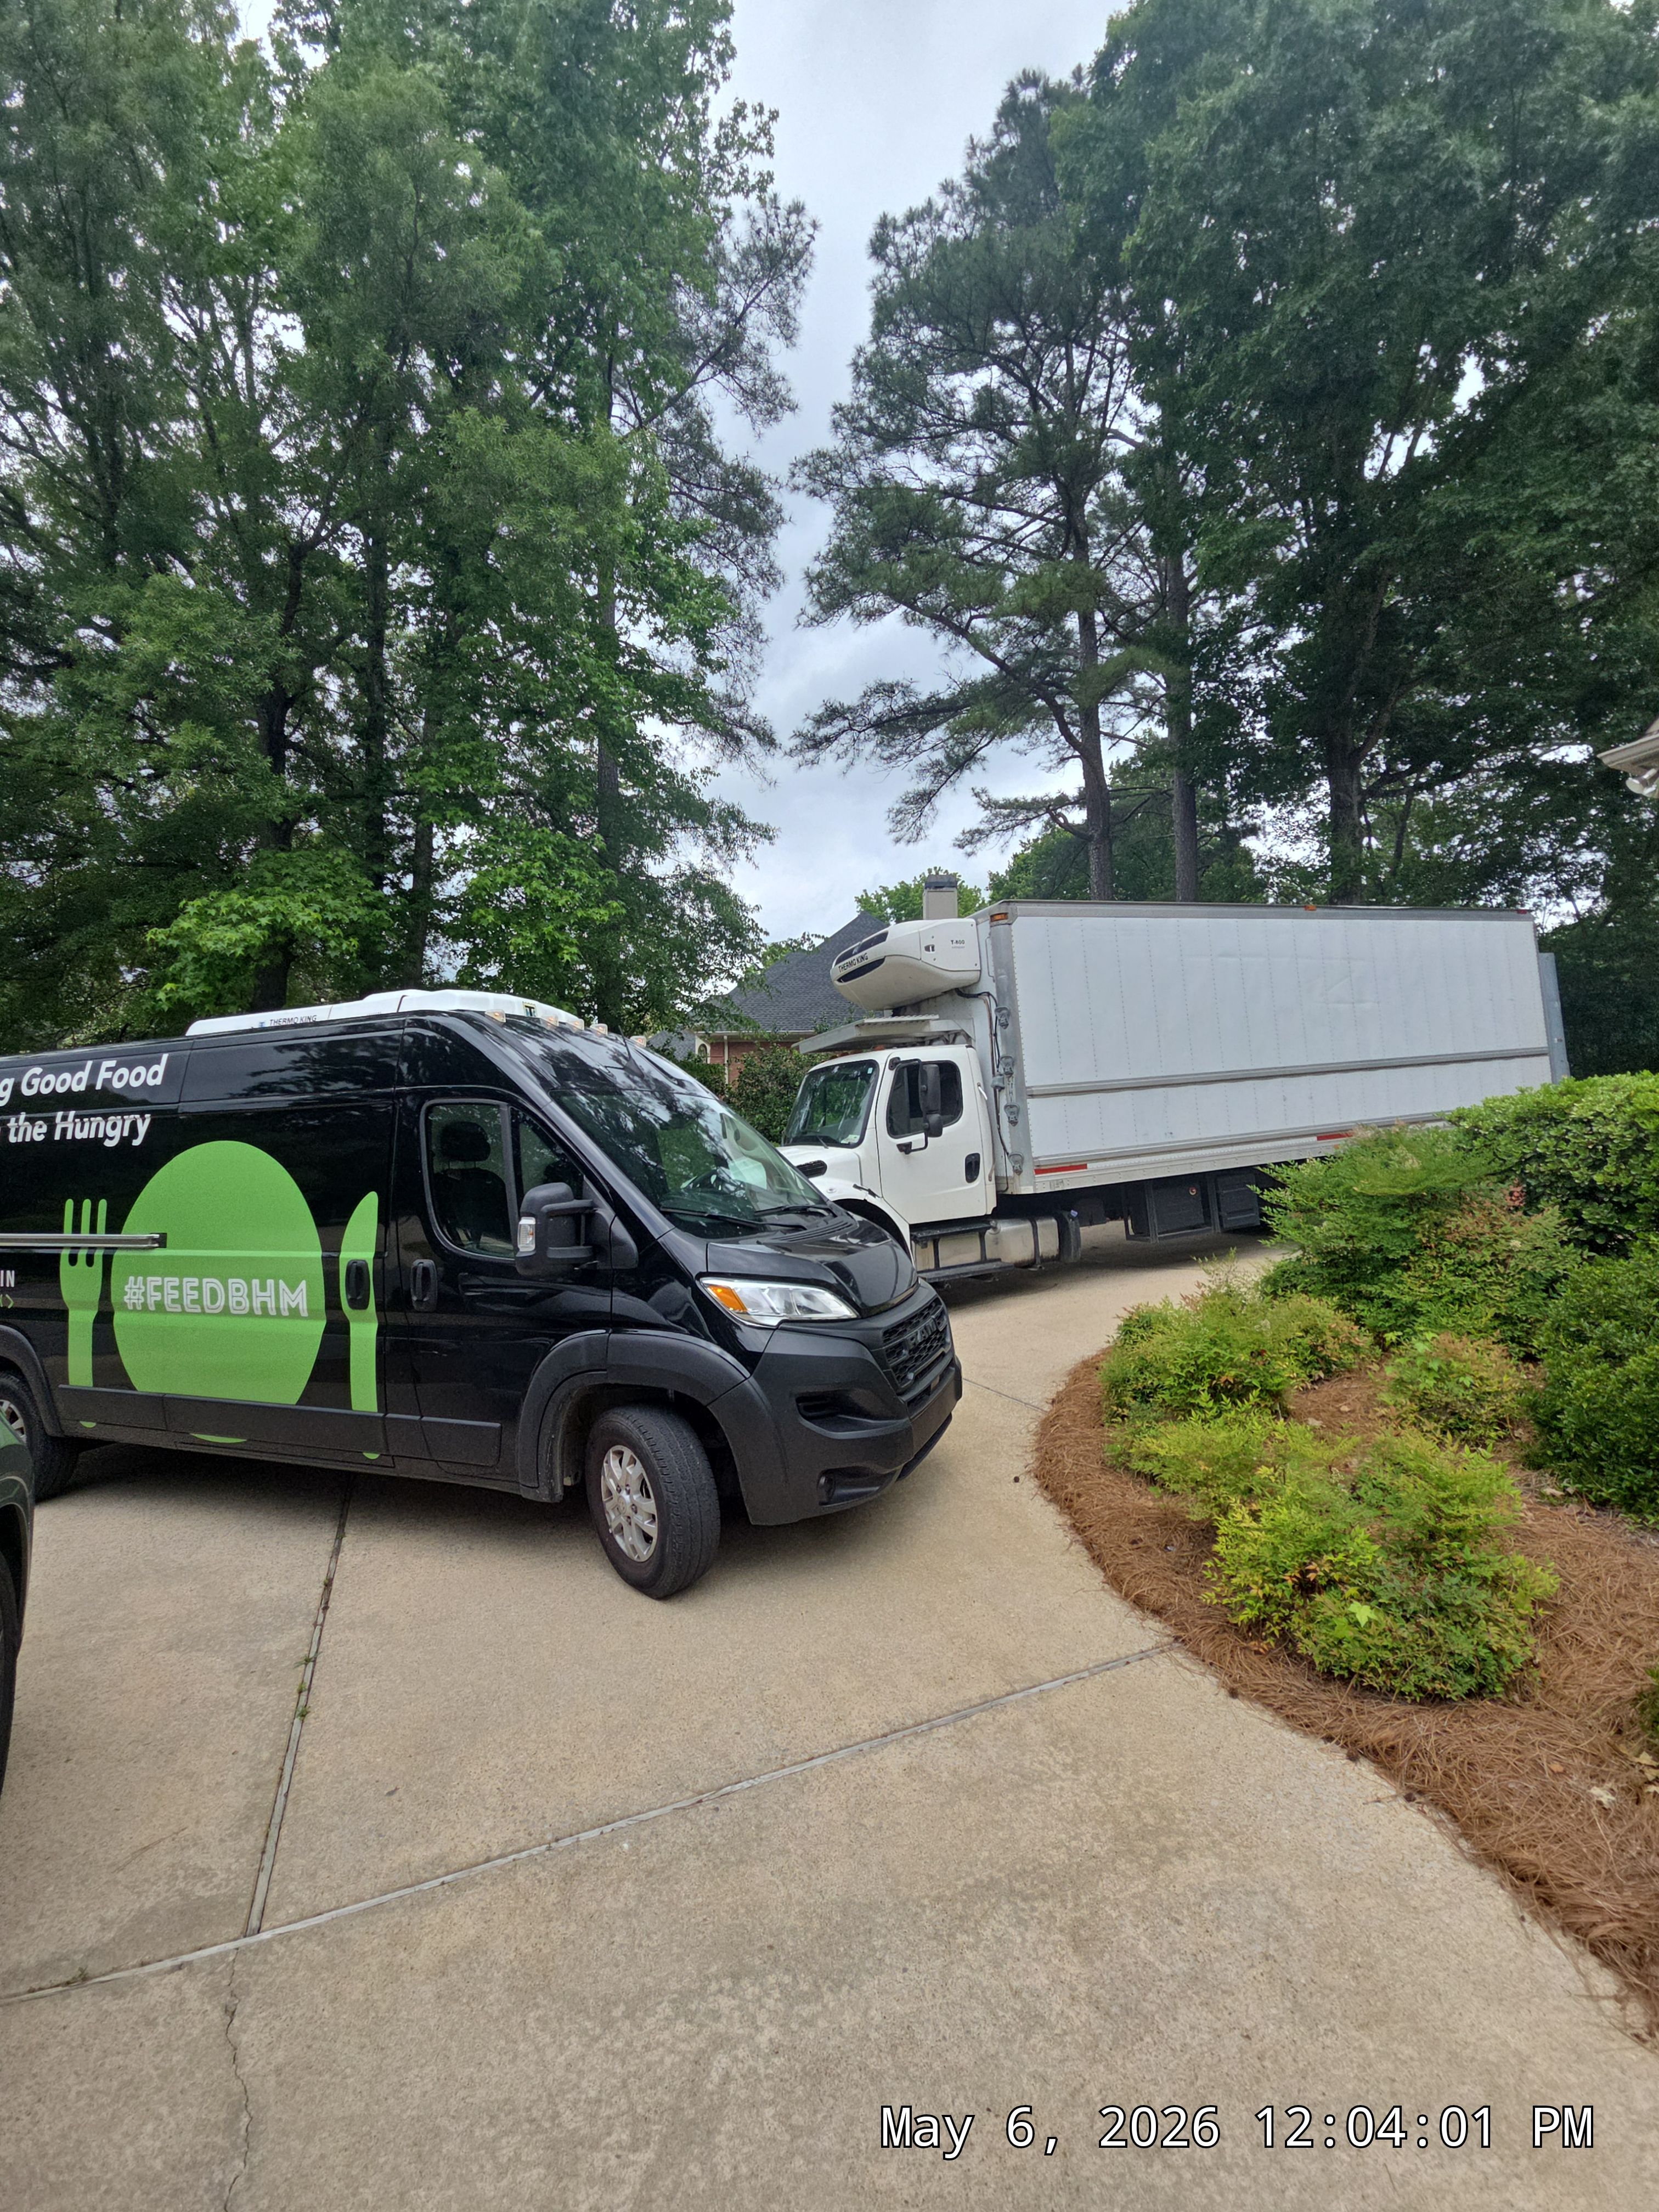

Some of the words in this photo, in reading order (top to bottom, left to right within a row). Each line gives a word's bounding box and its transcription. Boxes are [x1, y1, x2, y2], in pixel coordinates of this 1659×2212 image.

[838, 958, 856, 973] THERMO
[856, 952, 868, 964] KING
[269, 1017, 298, 1026] THERMO
[300, 1014, 317, 1023] KING
[21, 1060, 93, 1096] Good
[95, 1053, 169, 1090] Food
[7, 1112, 48, 1143] the
[54, 1110, 151, 1147] Hungry
[123, 1276, 308, 1317] #FEEDBHM
